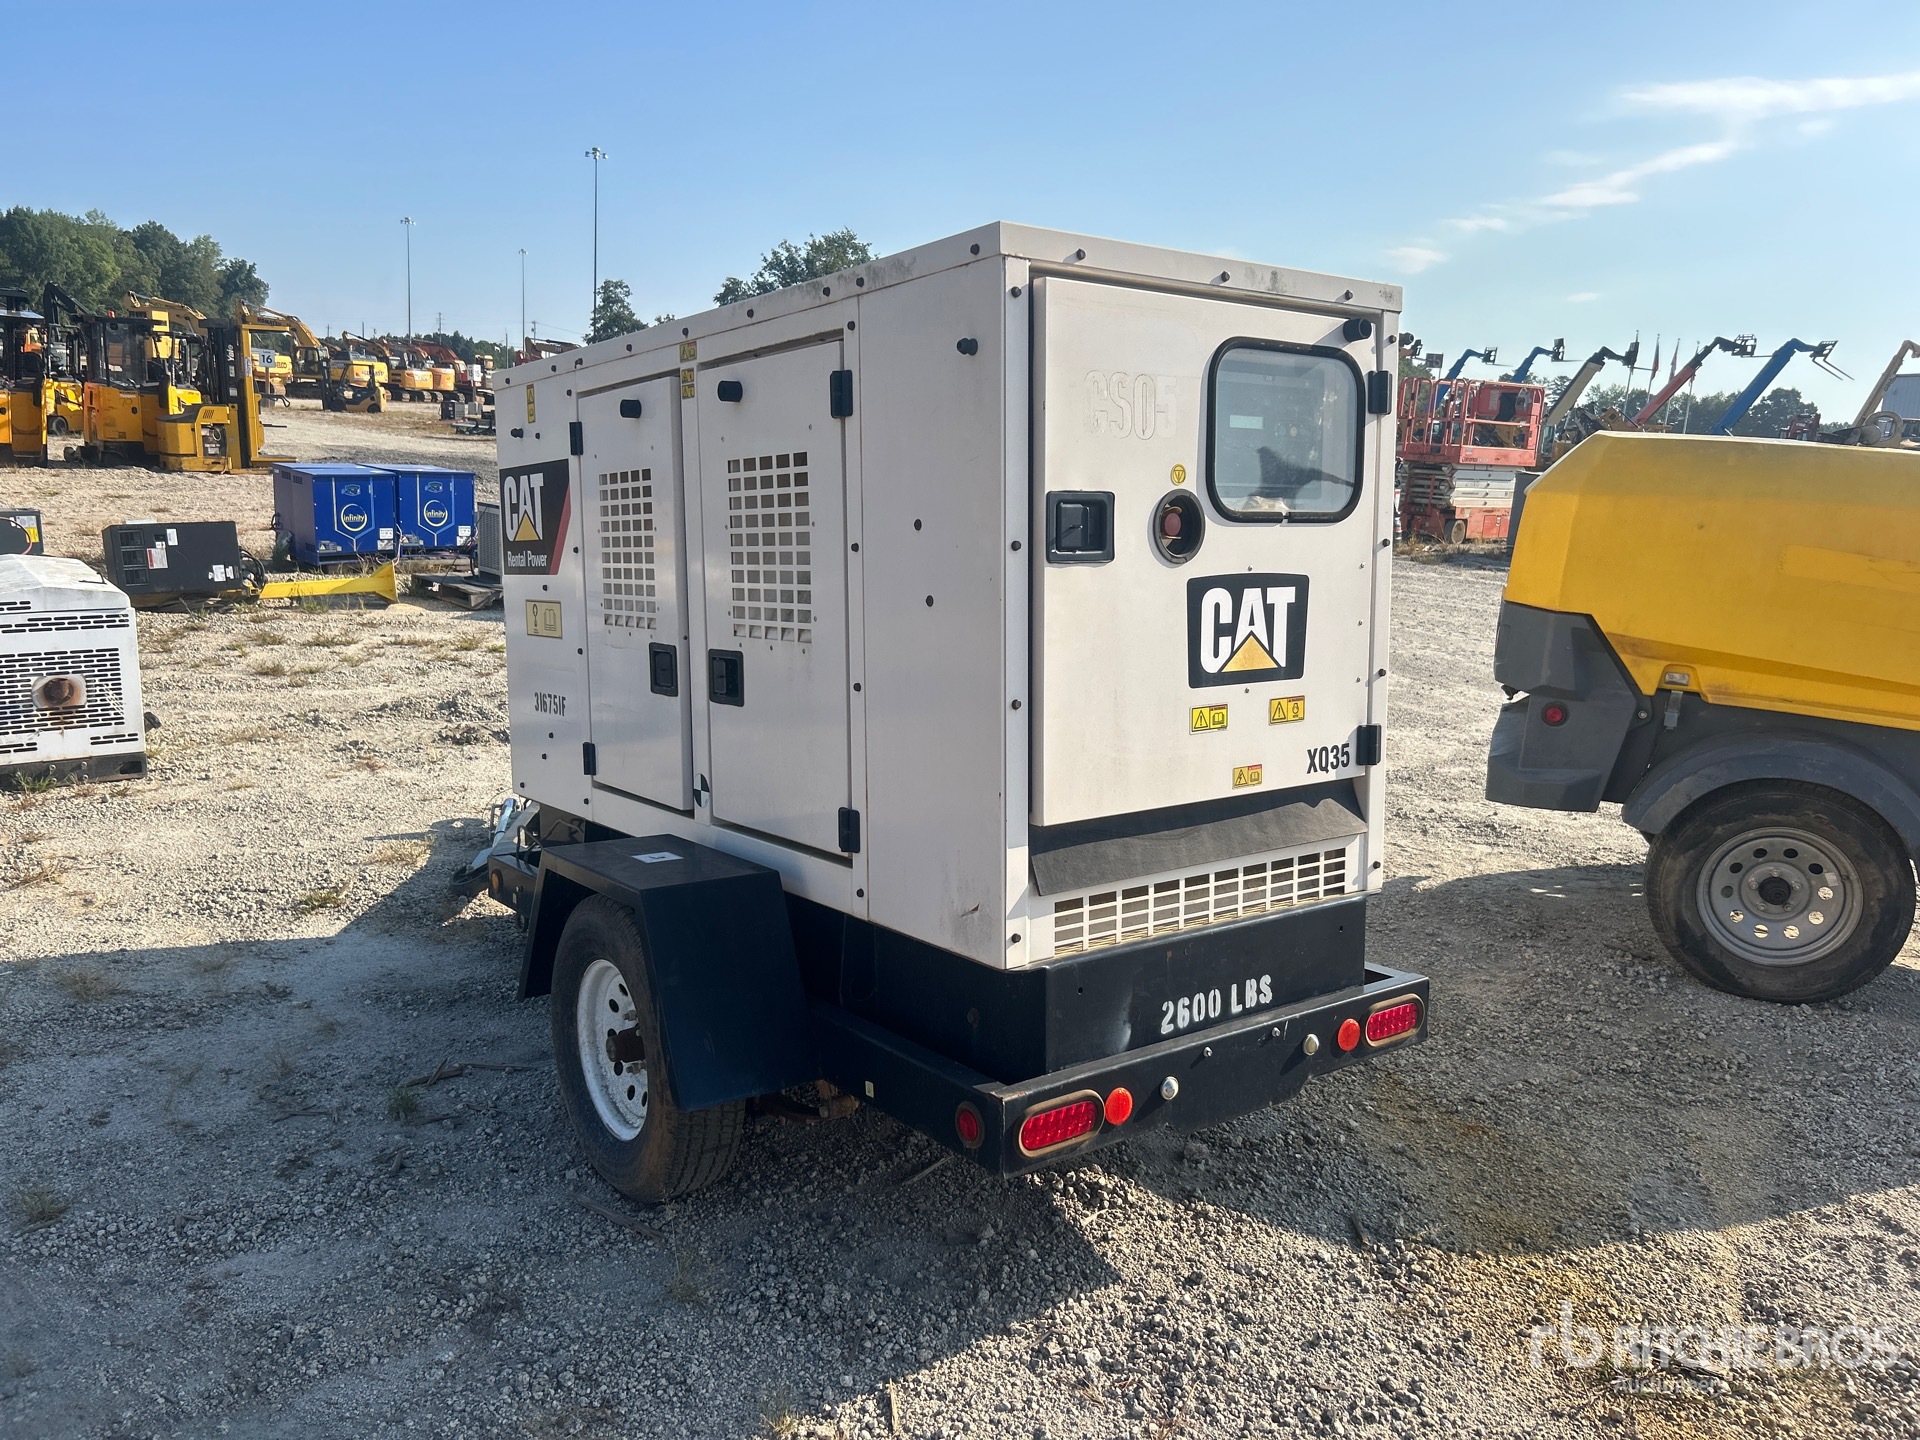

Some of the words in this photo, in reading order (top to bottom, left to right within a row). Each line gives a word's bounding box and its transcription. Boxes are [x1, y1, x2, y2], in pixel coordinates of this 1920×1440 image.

[227, 344, 235, 361] Yale
[261, 354, 273, 364] 16
[426, 509, 446, 519] infinity
[504, 472, 544, 542] CAT
[343, 513, 365, 523] infinity
[507, 551, 527, 567] Rental
[527, 550, 547, 567] Power
[1201, 586, 1296, 674] CAT
[534, 691, 567, 717] 316751F
[1306, 742, 1350, 775] XQ35
[1160, 988, 1222, 1035] 2600
[1231, 974, 1273, 1014] LBS
